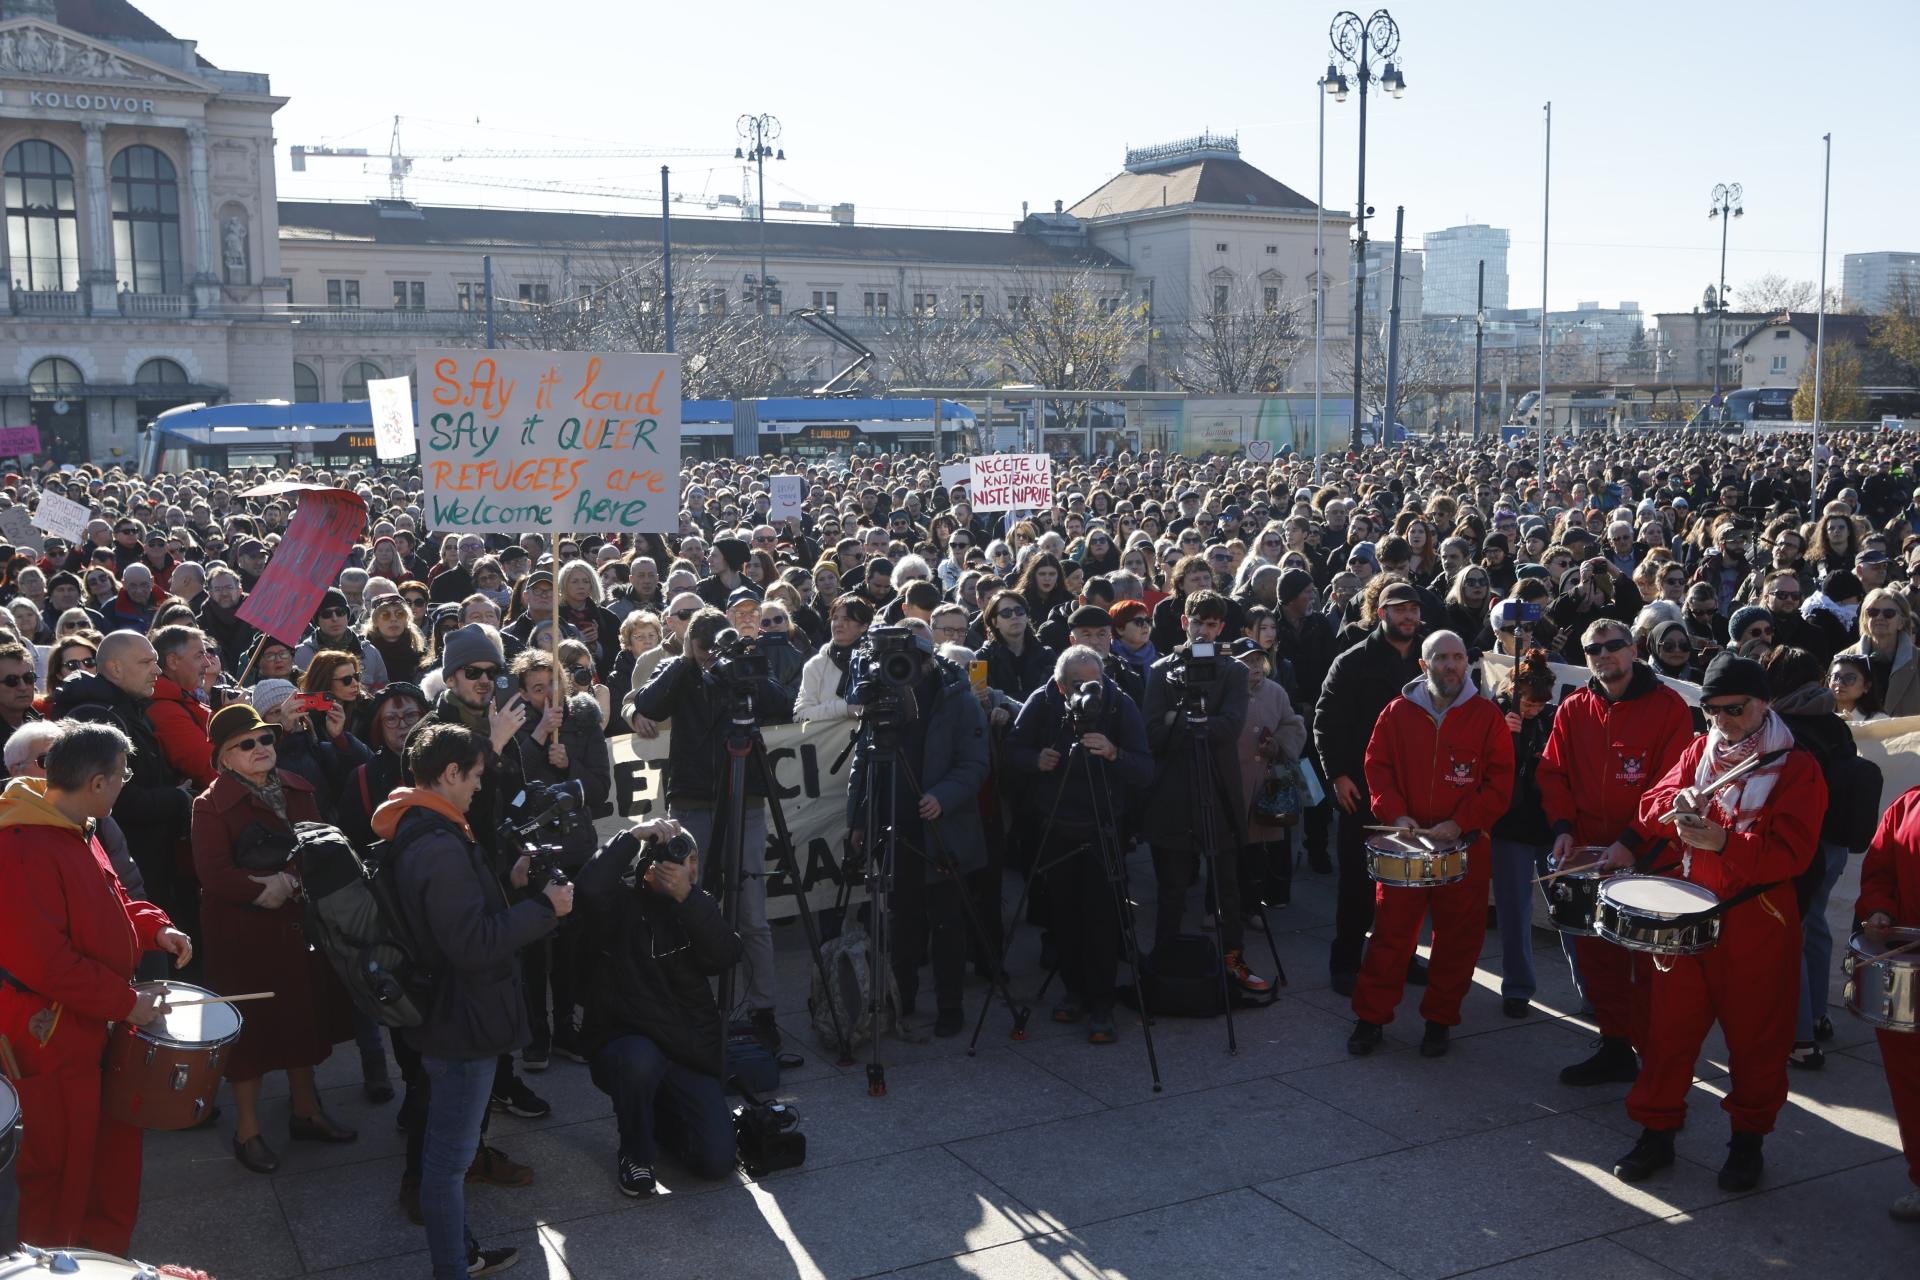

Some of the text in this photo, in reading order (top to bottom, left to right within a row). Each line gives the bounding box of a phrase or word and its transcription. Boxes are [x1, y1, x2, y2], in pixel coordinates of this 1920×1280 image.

[30, 91, 155, 113] KOLODVOR
[535, 366, 563, 411] it
[574, 356, 665, 415] loud
[520, 414, 544, 445] it
[557, 417, 660, 454] QUEER
[428, 457, 665, 500] REFUGEES are
[984, 471, 1049, 488] KNJIŽNICE
[1035, 458, 1046, 471] U
[573, 488, 648, 527] here
[973, 486, 1010, 507] NISTE
